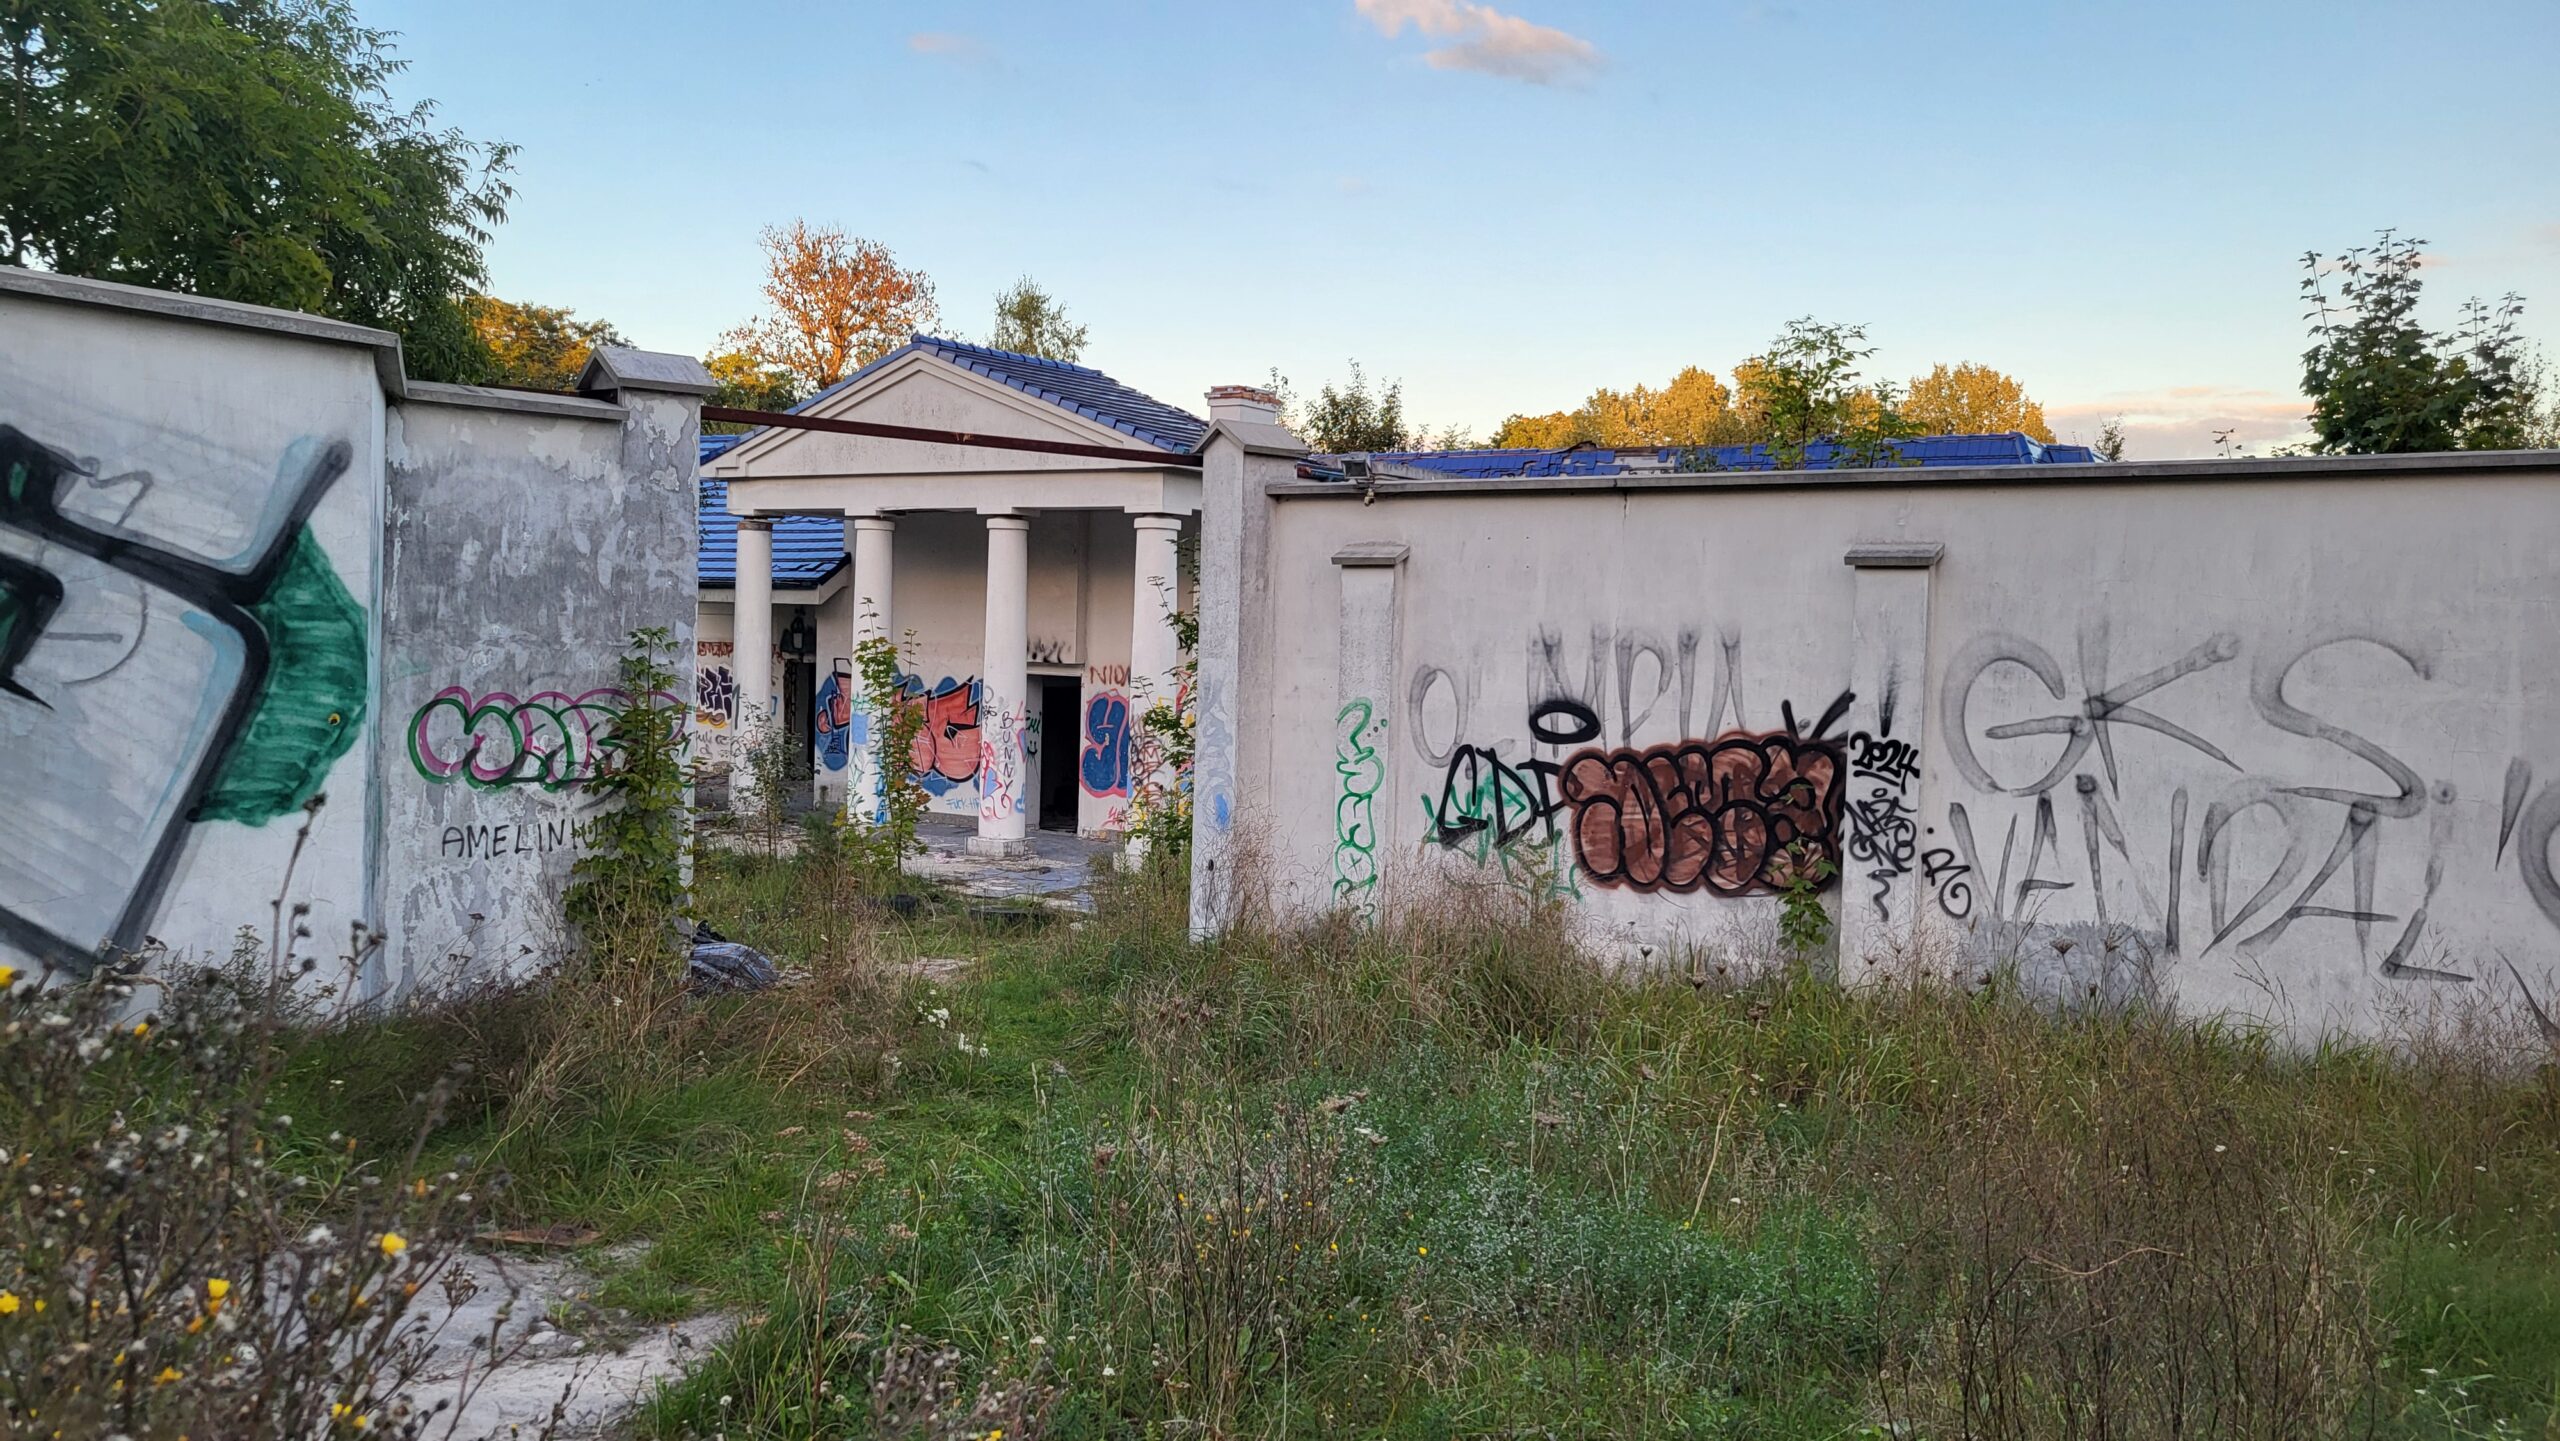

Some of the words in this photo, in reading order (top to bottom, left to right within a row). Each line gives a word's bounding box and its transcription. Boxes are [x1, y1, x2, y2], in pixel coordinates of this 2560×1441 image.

[1000, 711, 1015, 800] BUNNY
[1849, 731, 1920, 795] 2024
[1942, 618, 2431, 819] GKS
